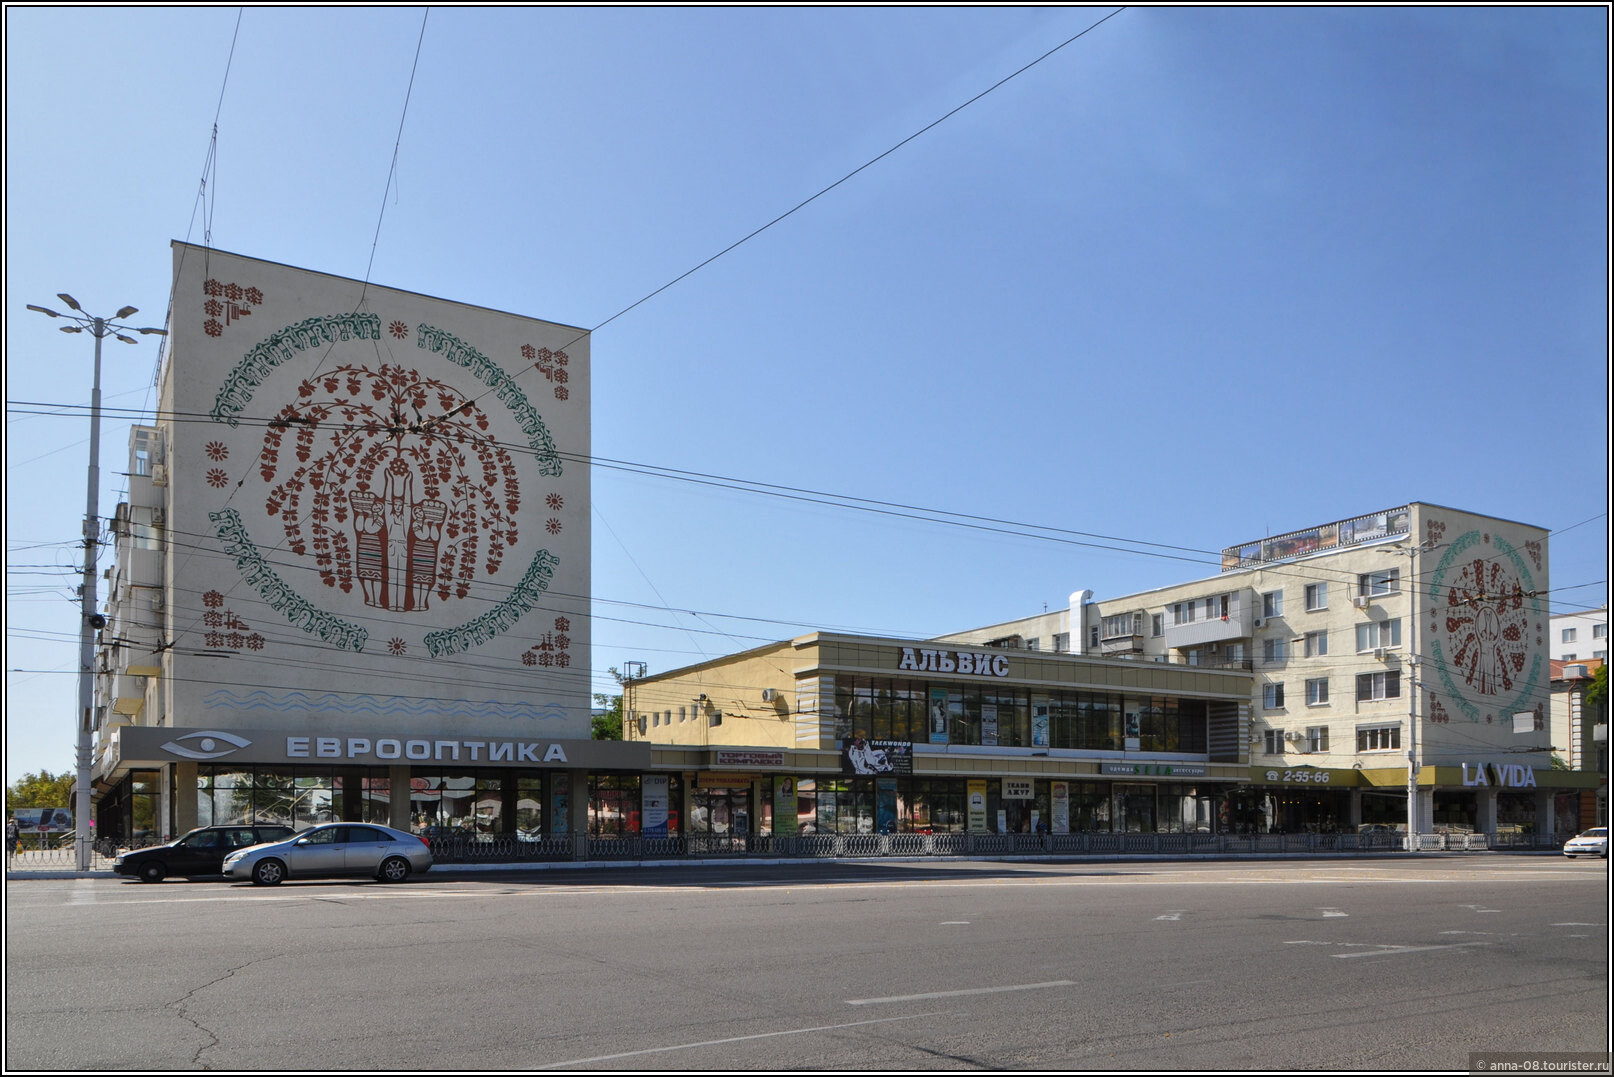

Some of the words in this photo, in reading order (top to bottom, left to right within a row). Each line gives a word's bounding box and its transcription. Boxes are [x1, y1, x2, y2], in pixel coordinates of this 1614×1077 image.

[899, 647, 1009, 677] АЛЬВИС
[286, 736, 569, 763] ЕВРООПТИКА
[1134, 763, 1172, 776] SELA
[1283, 770, 1330, 783] 2-55-66
[1462, 762, 1489, 787] LA
[1496, 763, 1537, 788] VIDA
